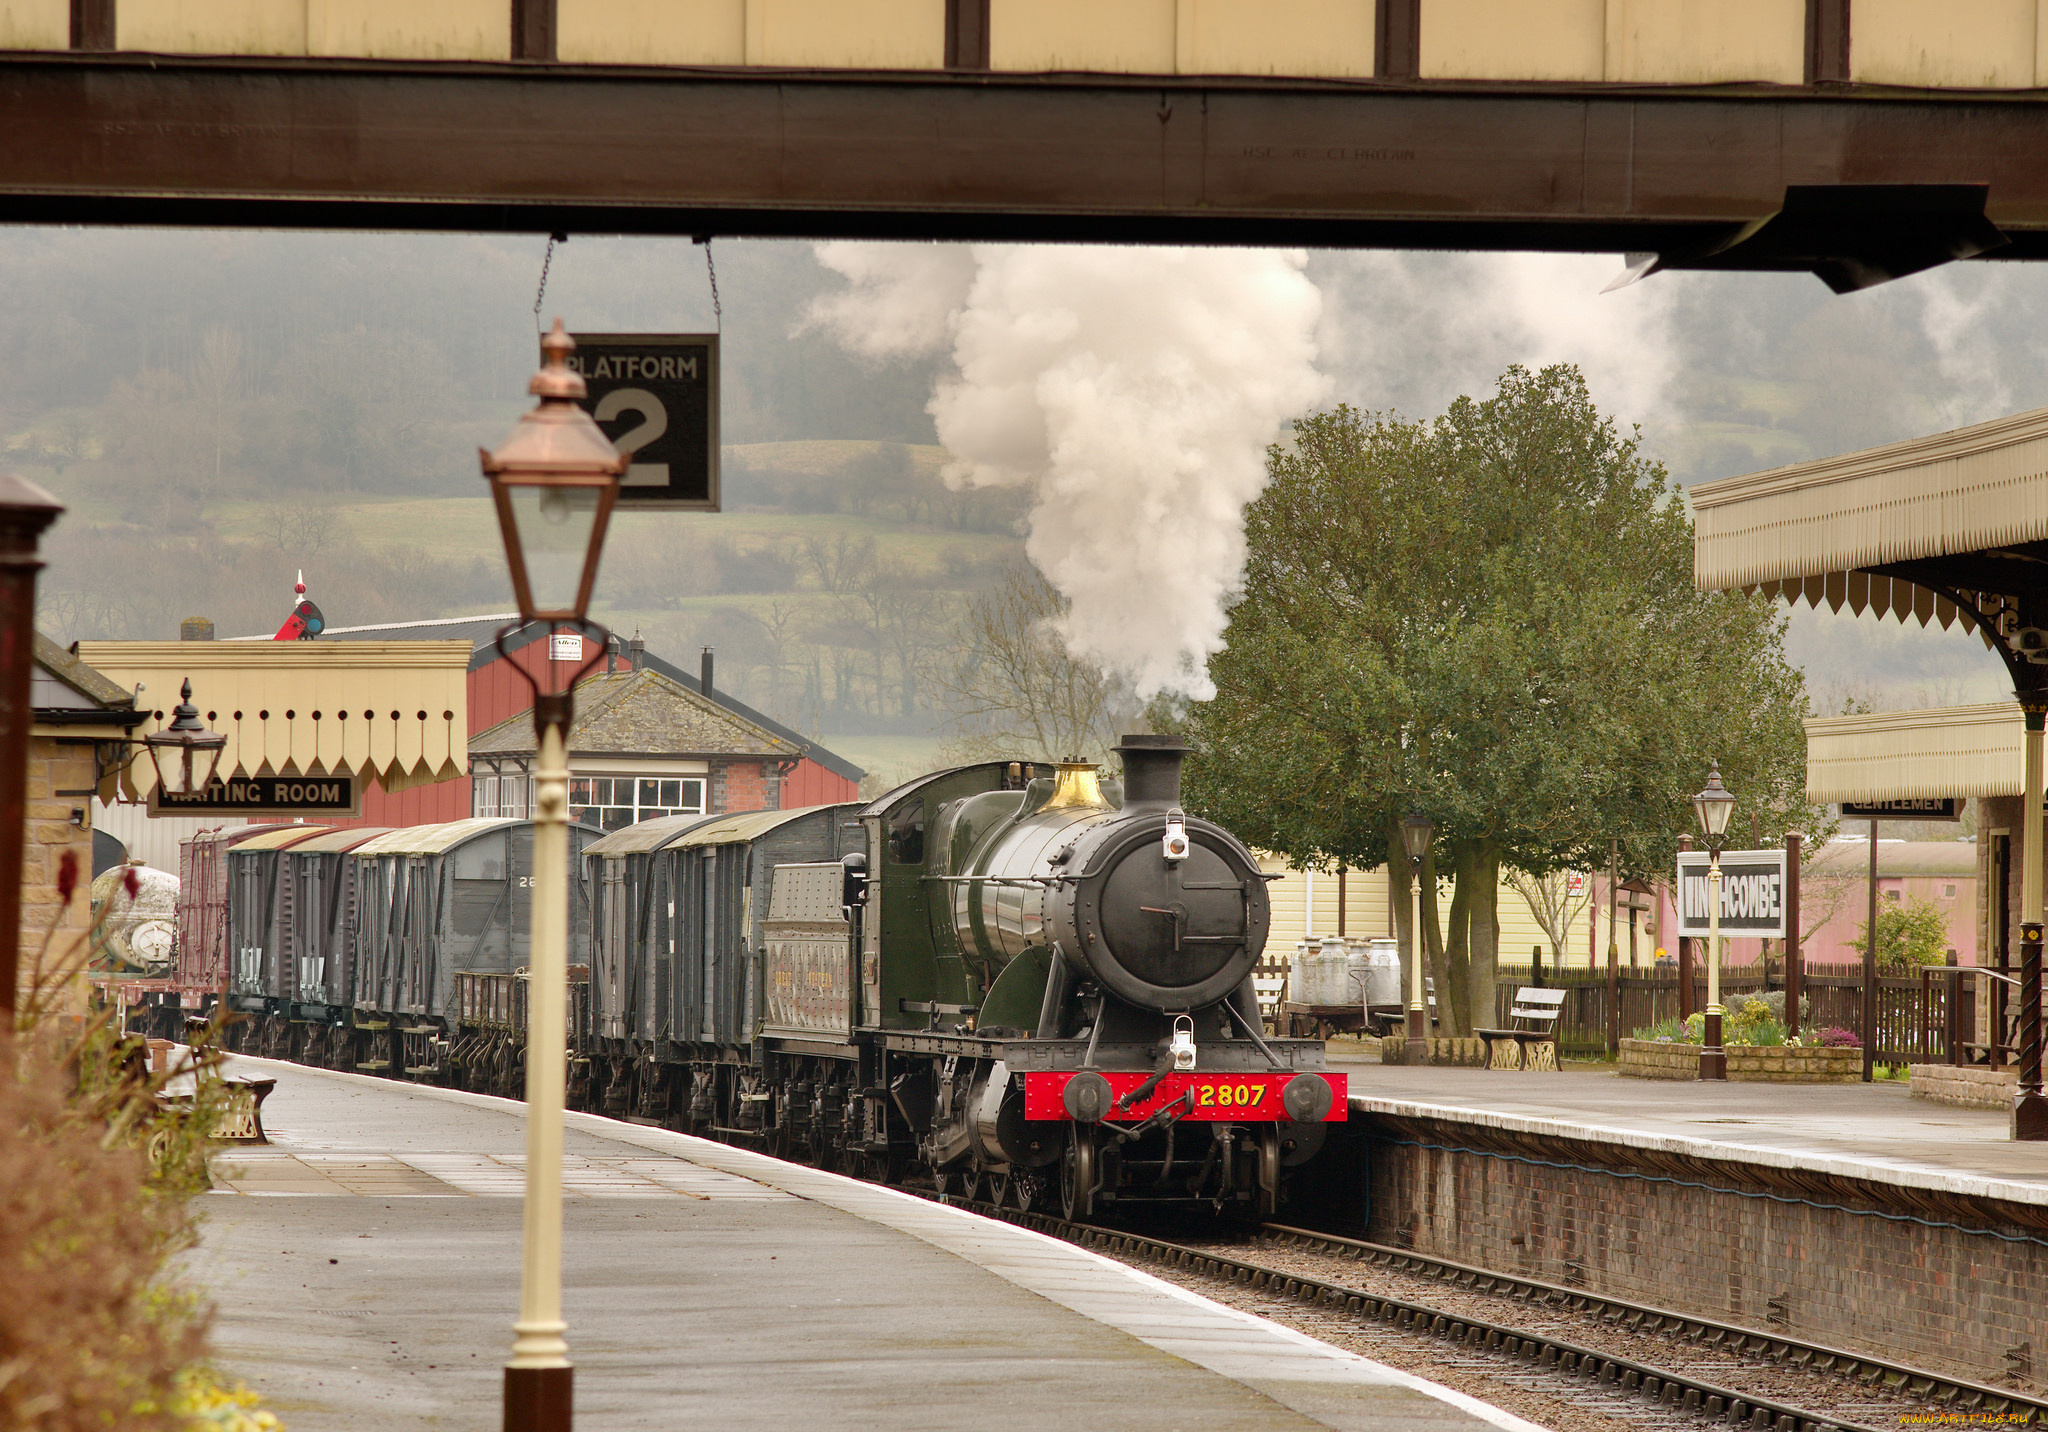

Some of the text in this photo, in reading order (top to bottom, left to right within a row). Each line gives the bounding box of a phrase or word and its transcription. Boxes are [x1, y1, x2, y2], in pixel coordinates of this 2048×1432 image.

[565, 356, 697, 379] PLATFORM
[594, 387, 670, 487] 2
[171, 783, 340, 803] TING ROOM
[1852, 798, 1944, 811] GENTLEMEN
[1684, 873, 1781, 919] WINHCOMBE
[1200, 1084, 1266, 1107] 2807
